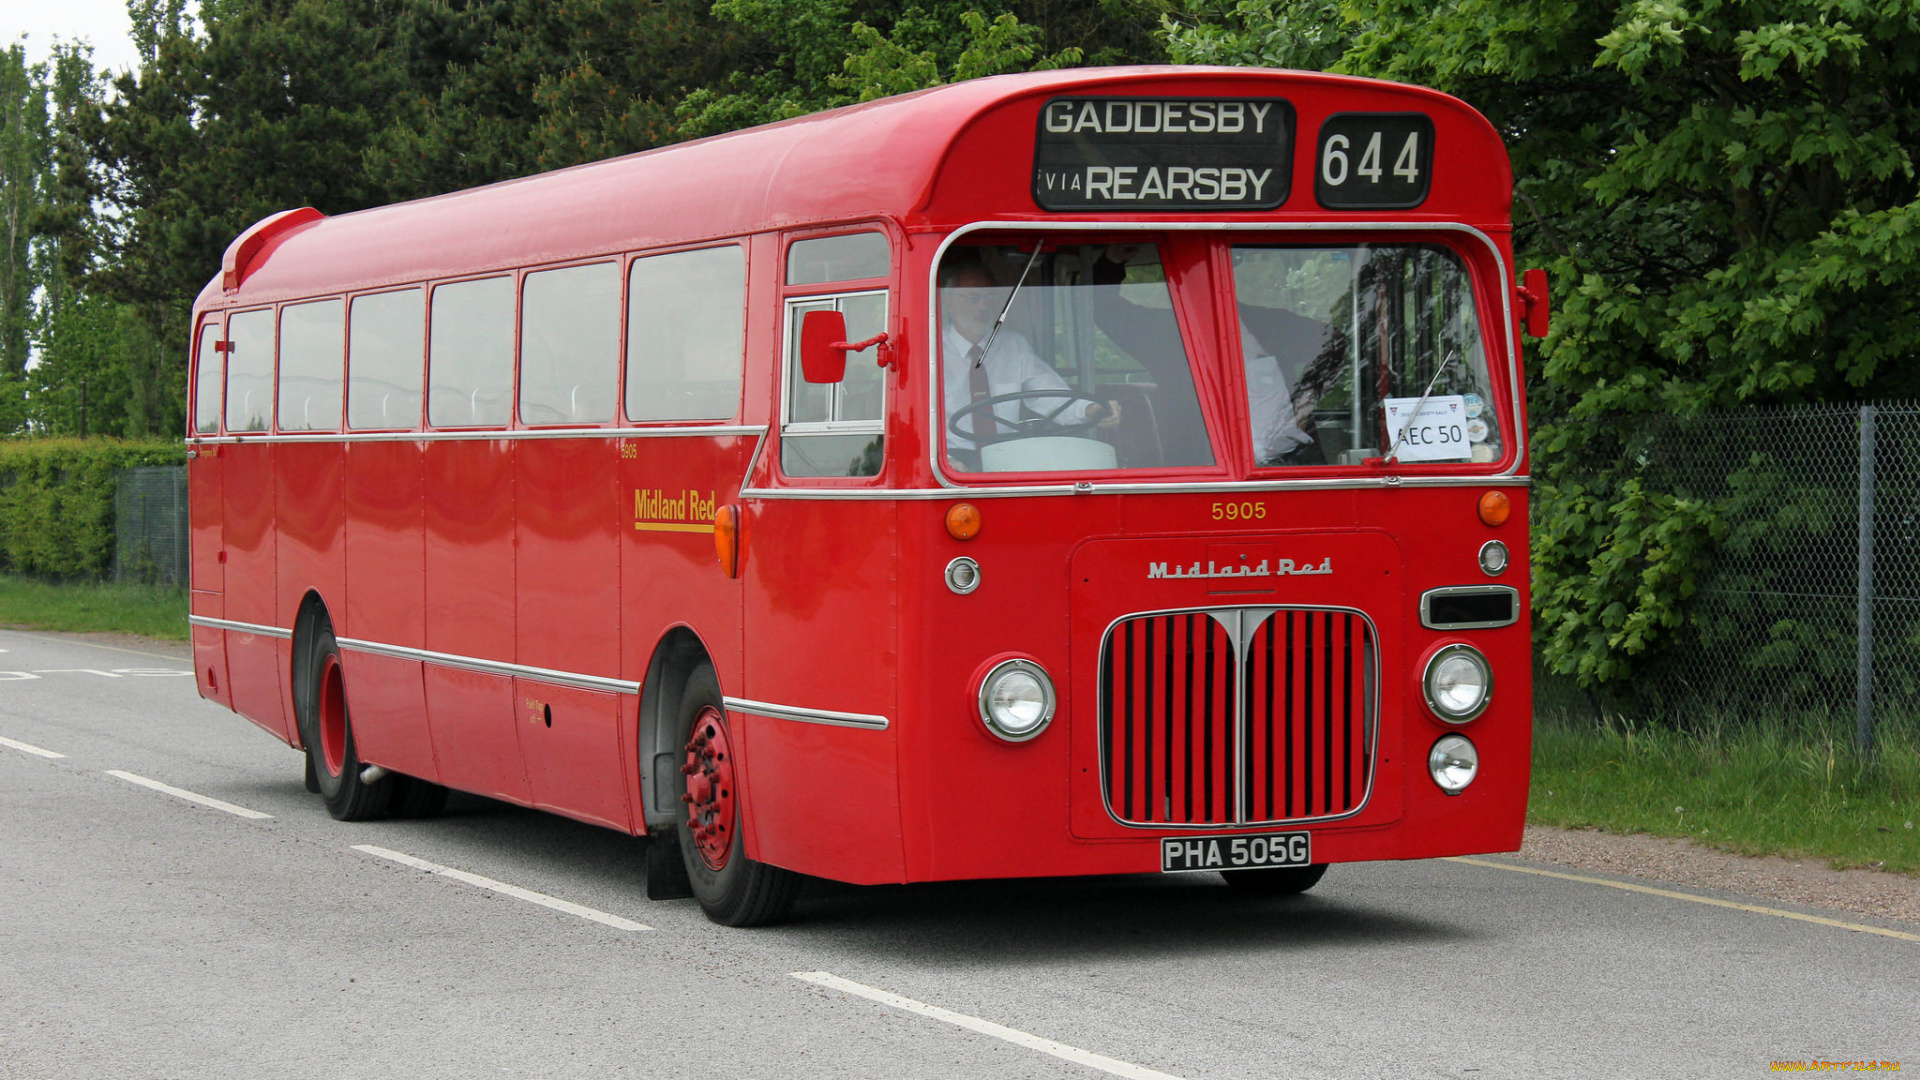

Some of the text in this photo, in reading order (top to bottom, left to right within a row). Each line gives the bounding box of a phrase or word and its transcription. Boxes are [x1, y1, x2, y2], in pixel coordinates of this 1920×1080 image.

[1046, 101, 1273, 133] GADDESBY
[1322, 131, 1419, 186] 644
[1046, 166, 1273, 200] VIA REARSBY
[1438, 425, 1462, 444] 50
[621, 444, 637, 459] 5905
[635, 488, 715, 520] Midland Red
[1212, 502, 1266, 520] 5905
[1147, 557, 1333, 579] Midland Red
[1165, 835, 1307, 869] PHA 505G
